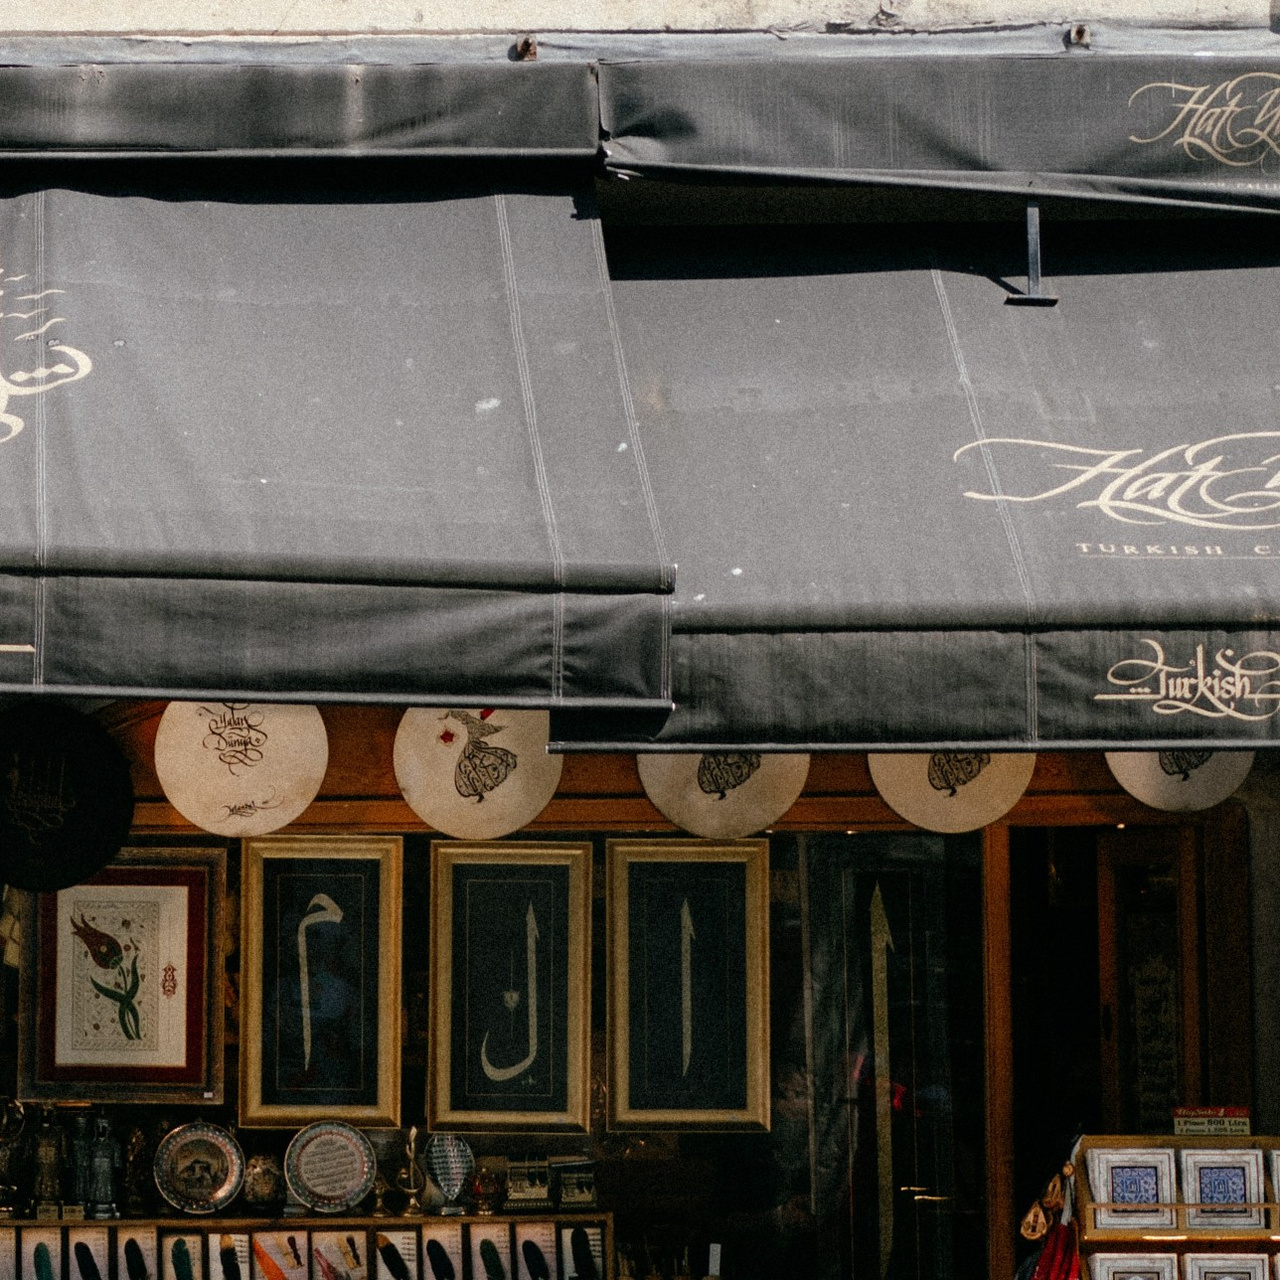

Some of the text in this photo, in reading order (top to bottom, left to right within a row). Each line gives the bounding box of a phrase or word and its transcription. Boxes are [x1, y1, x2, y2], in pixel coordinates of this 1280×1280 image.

[1128, 81, 1244, 166] Hat
[1075, 542, 1224, 556] TURKISH
[1094, 638, 1280, 721] Turkish
